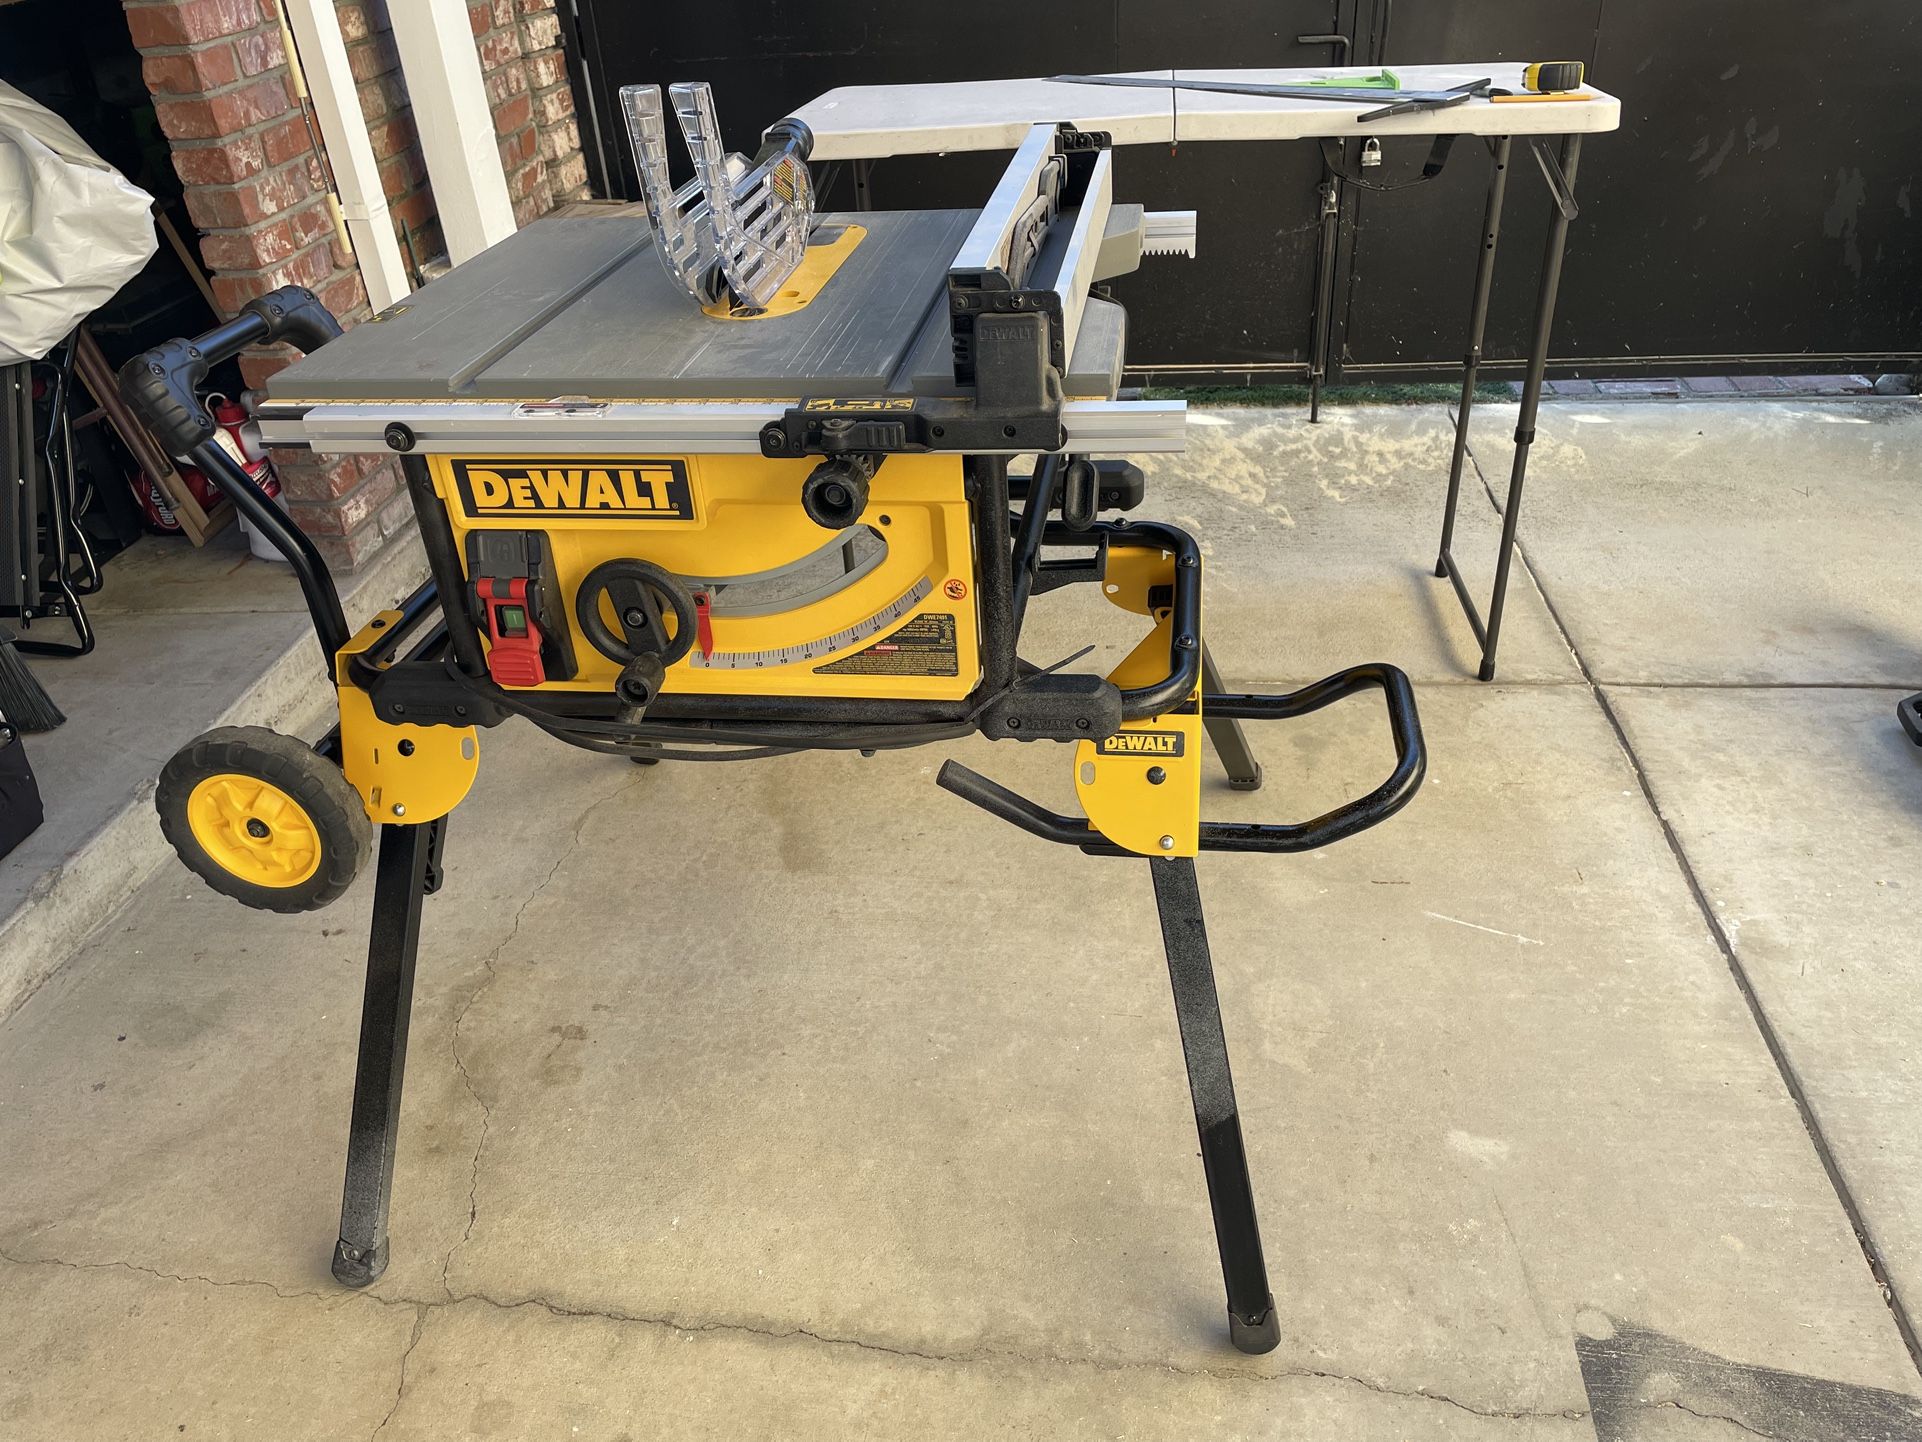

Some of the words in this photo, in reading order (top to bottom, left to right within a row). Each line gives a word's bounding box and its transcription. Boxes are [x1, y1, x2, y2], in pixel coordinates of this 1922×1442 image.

[467, 470, 674, 509] DEWALT
[828, 645, 837, 653] 25
[894, 610, 902, 618] 40
[913, 595, 921, 603] 45
[1104, 736, 1177, 751] DEWALT
